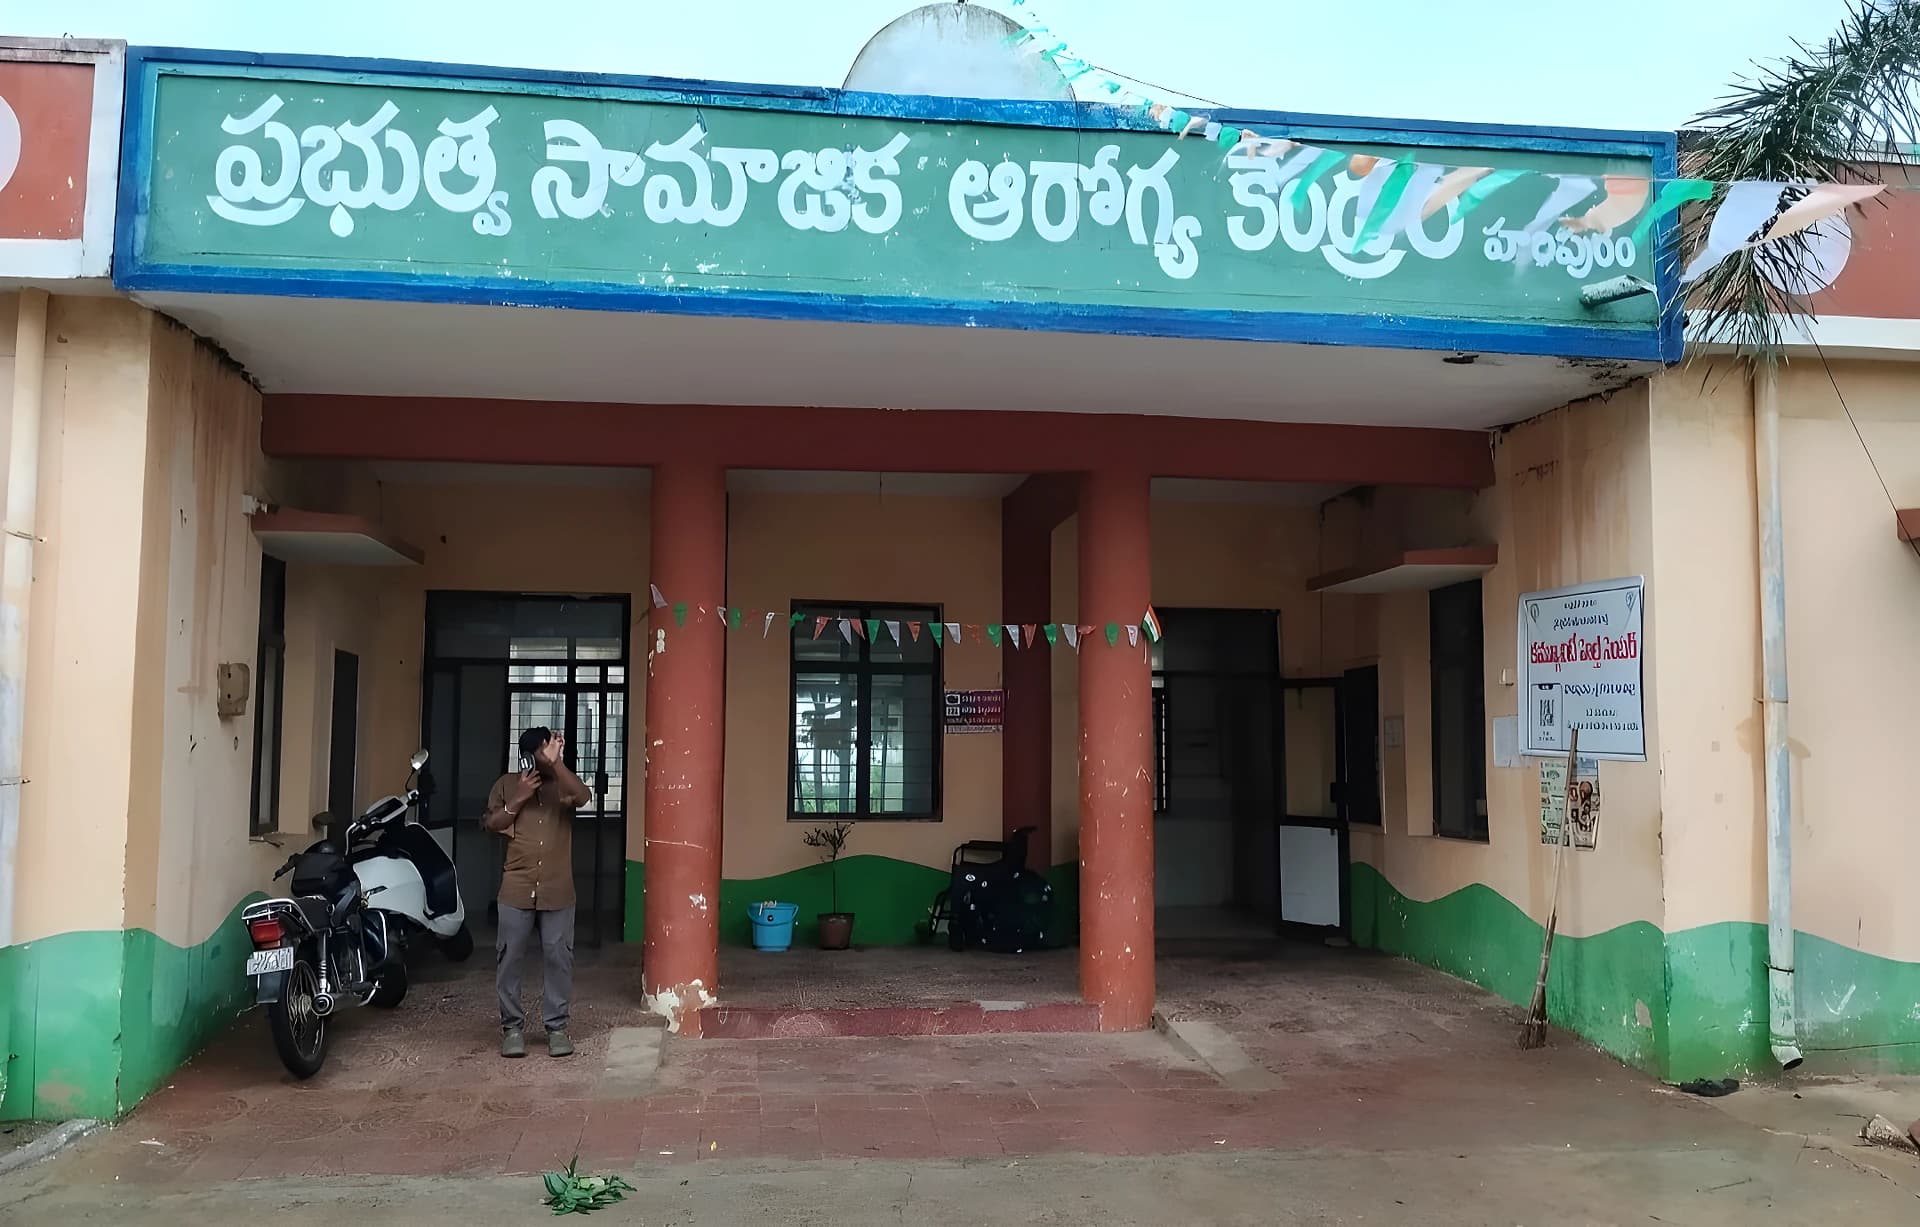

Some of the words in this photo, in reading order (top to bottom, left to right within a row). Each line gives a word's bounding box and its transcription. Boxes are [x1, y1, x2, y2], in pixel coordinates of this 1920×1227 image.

[206, 94, 512, 237] ప్రభుత్వ
[530, 119, 911, 235] సామాజిక
[948, 145, 1202, 280] ఆరోగ్య
